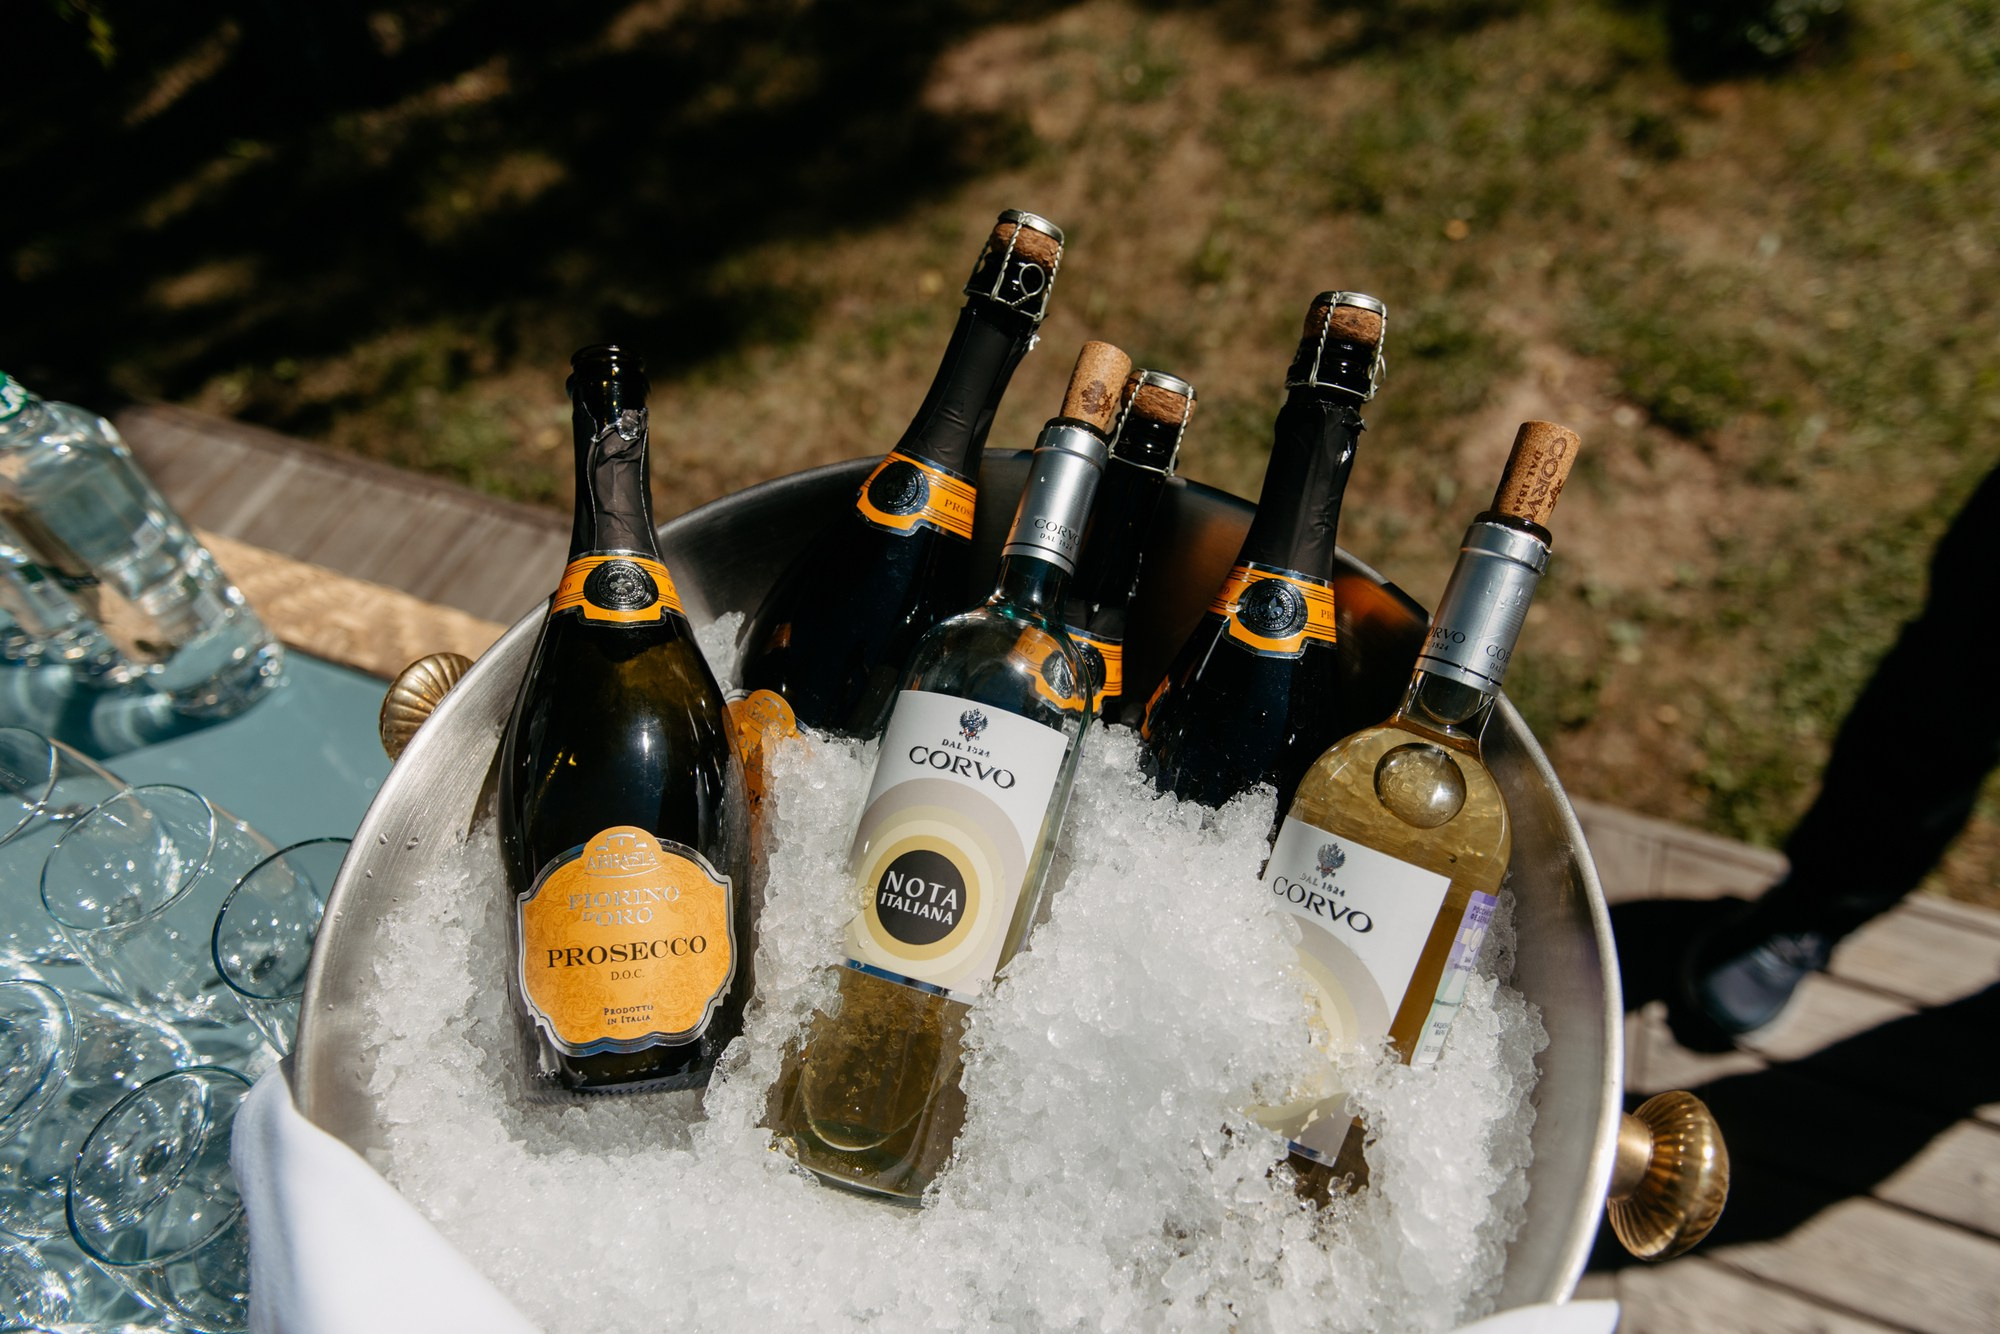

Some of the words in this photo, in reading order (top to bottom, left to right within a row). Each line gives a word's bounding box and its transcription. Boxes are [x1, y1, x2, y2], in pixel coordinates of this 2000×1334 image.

[1034, 518, 1080, 546] CORVO
[1486, 644, 1511, 662] COR
[941, 739, 962, 751] DAL
[909, 745, 1016, 790] CORVO
[568, 886, 680, 911] FIORINO
[885, 870, 958, 911] NOTA
[1299, 872, 1319, 887] DAL
[1321, 882, 1346, 898] 1824
[880, 892, 954, 926] ITALIANA
[1273, 876, 1374, 934] CORVO
[547, 935, 708, 968] PROSECCO
[610, 968, 646, 981] D.O.C.
